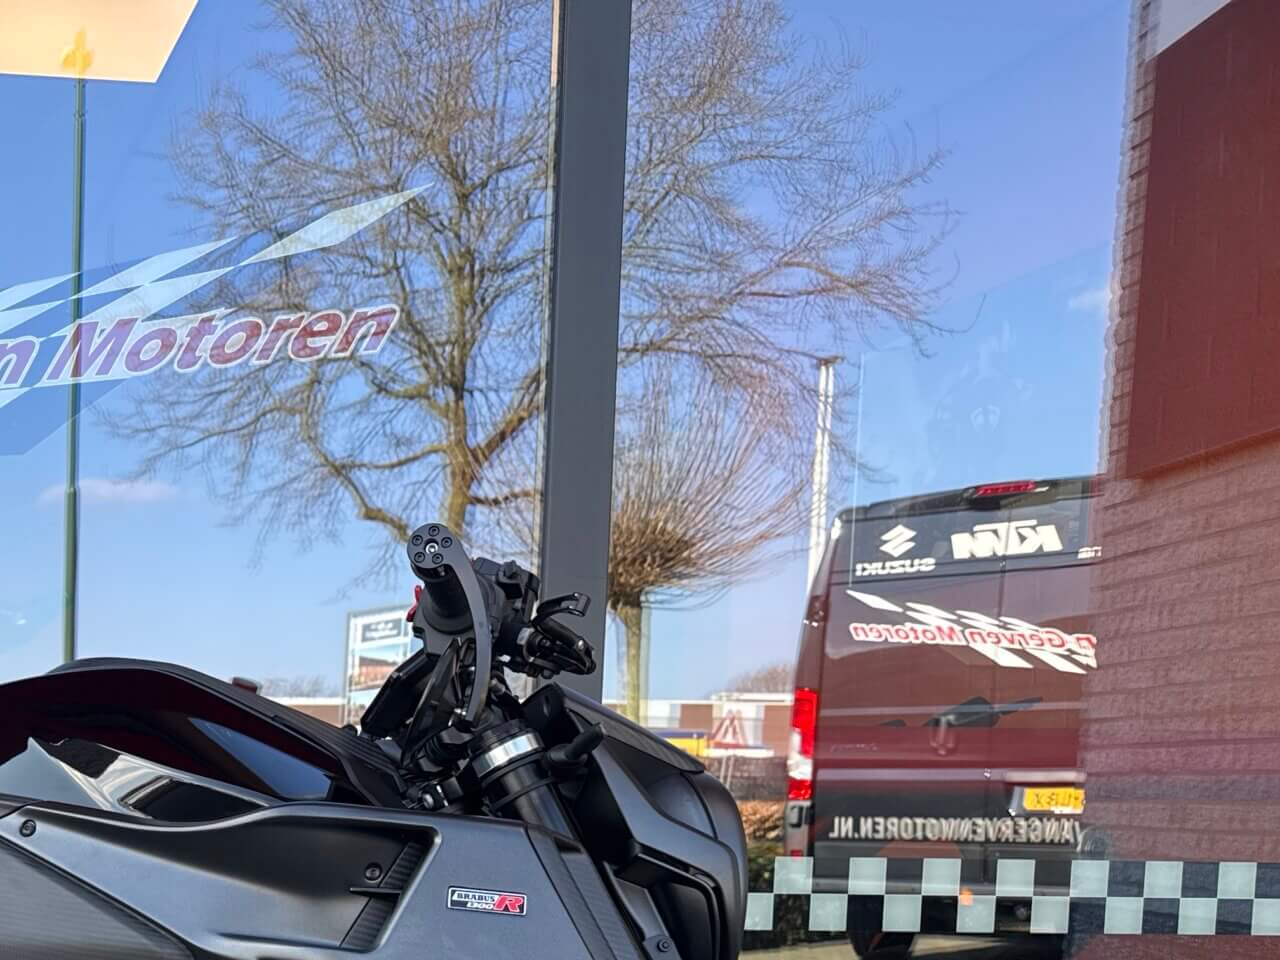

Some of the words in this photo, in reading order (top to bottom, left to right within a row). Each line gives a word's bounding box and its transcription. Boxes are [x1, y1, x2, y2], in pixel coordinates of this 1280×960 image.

[48, 305, 399, 382] Motoren
[457, 893, 494, 902] BRABUS
[494, 895, 524, 912] R
